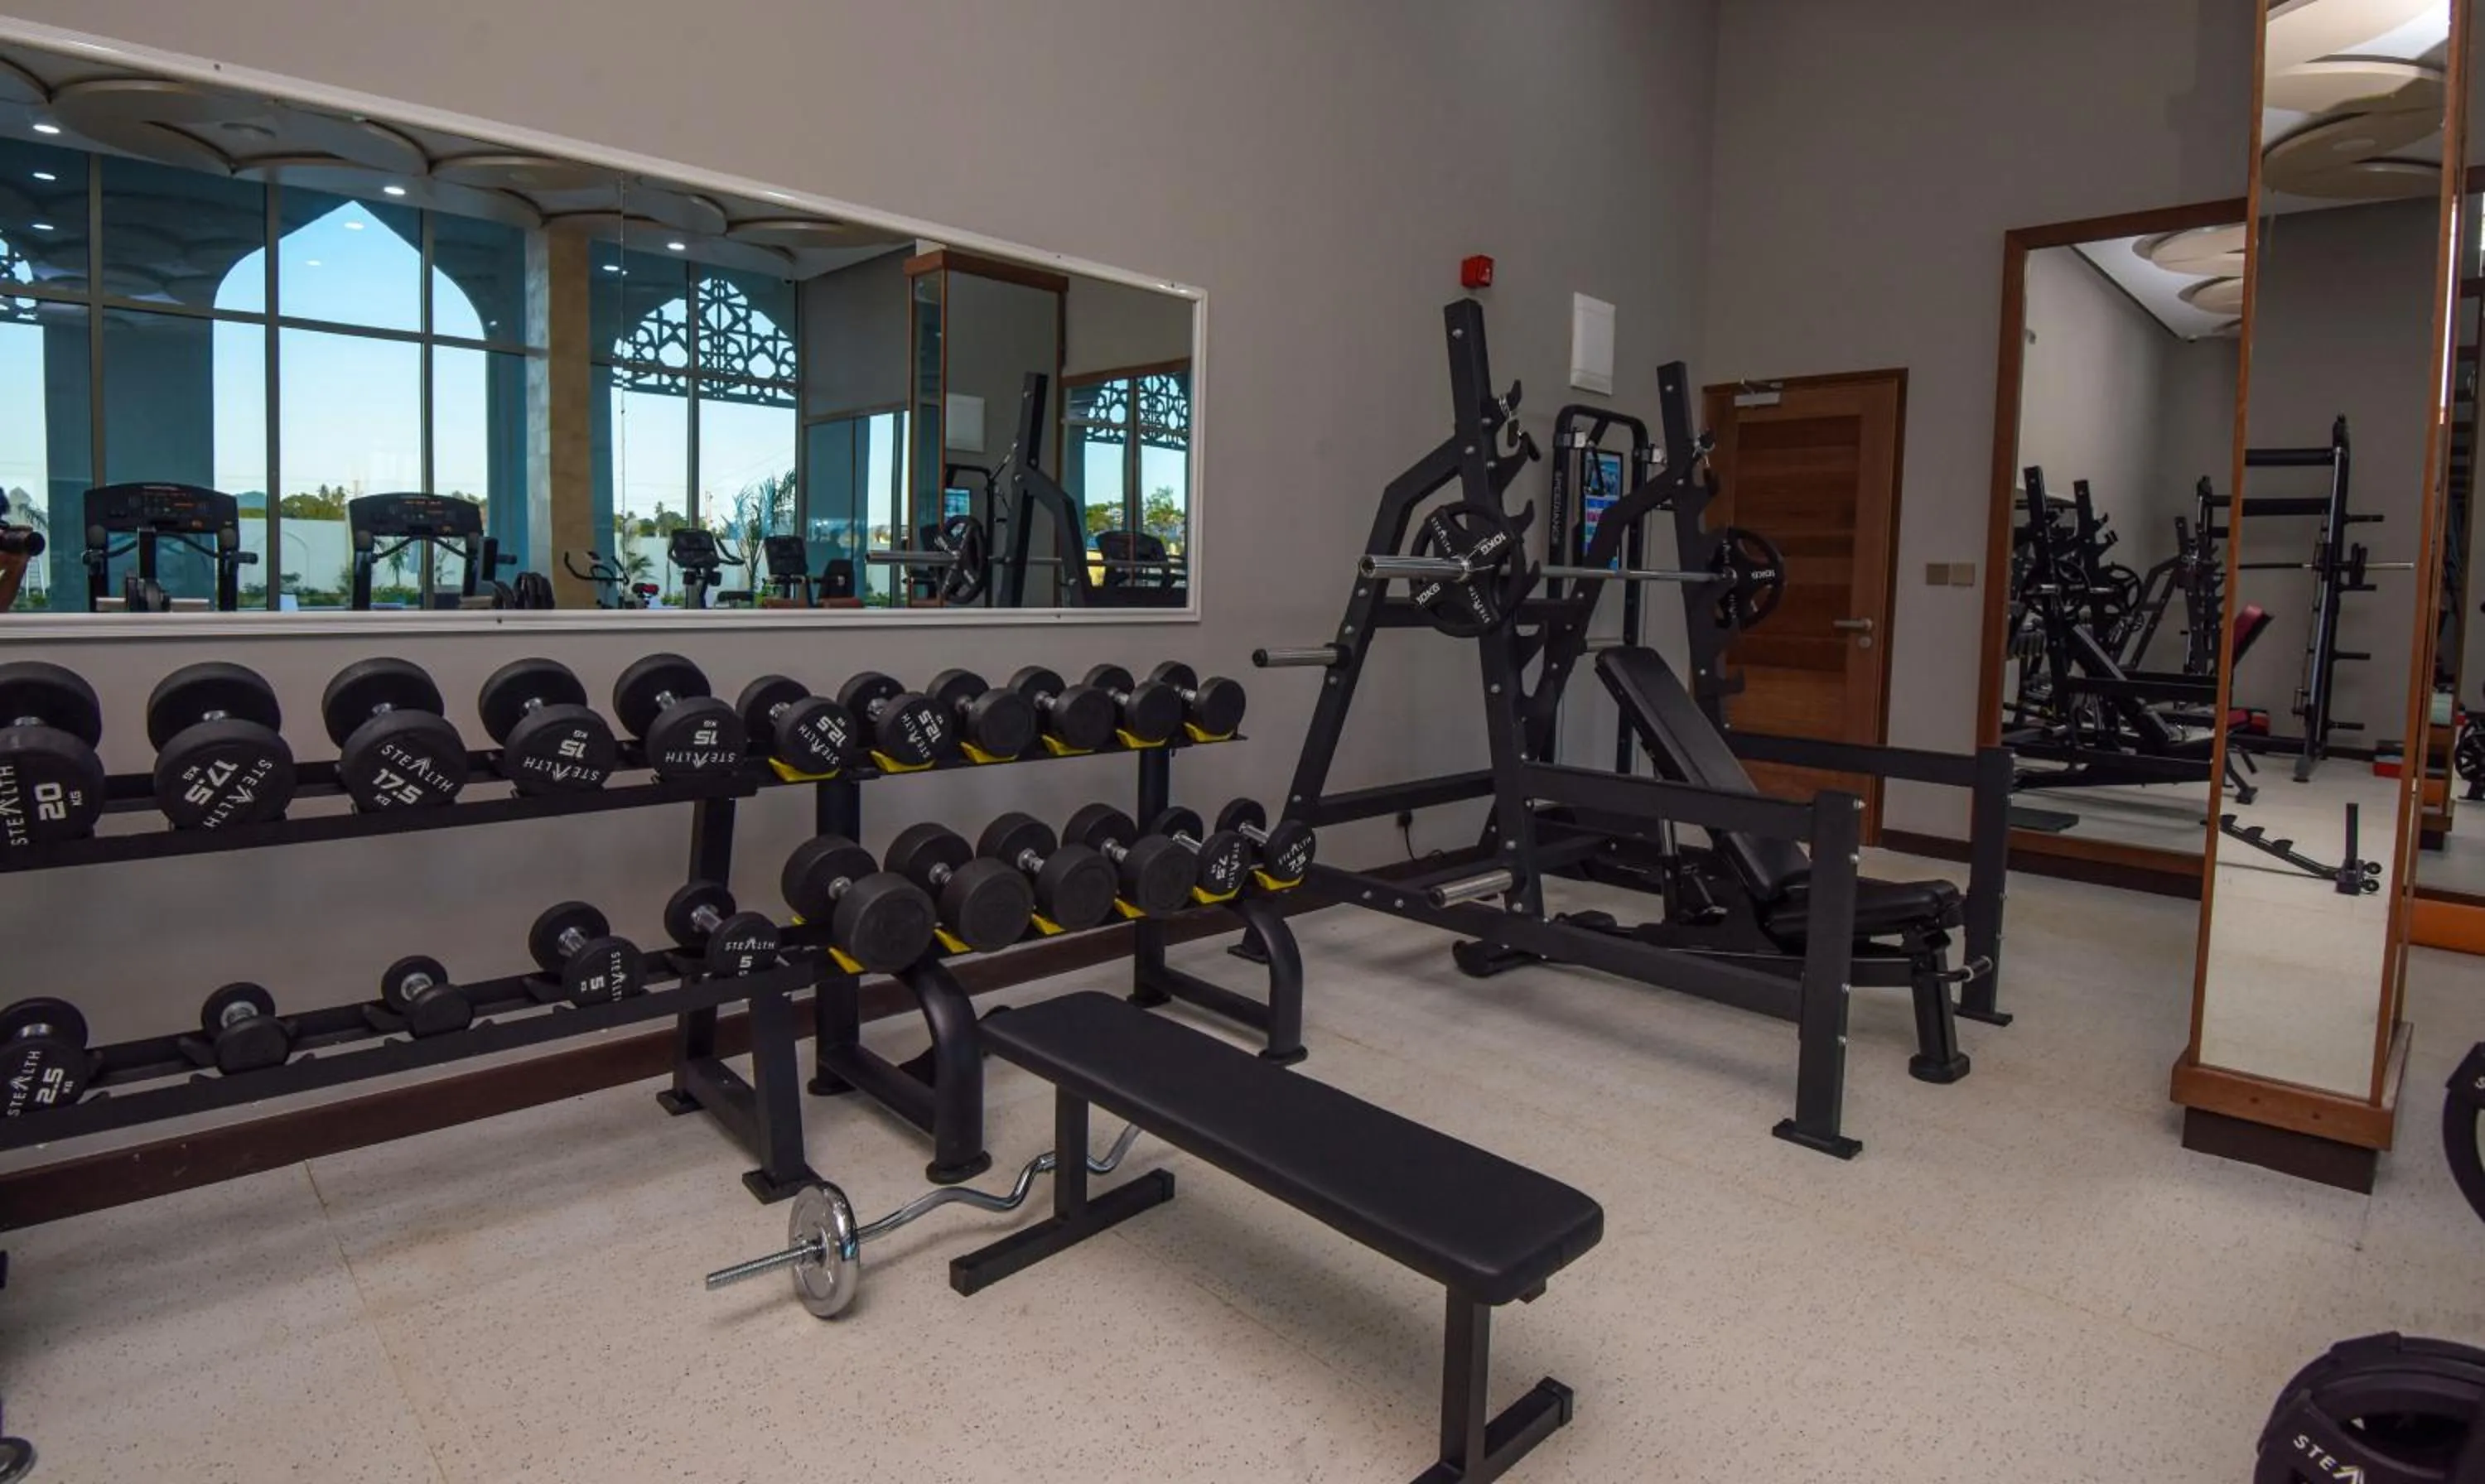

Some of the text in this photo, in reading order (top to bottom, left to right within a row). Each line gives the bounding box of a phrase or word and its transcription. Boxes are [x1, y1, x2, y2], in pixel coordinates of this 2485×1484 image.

[694, 730, 717, 744] 15
[816, 716, 847, 747] 12.5
[901, 713, 931, 758] STEALTH
[919, 710, 942, 742] 12.5
[558, 740, 586, 758] 15
[665, 752, 736, 768] STEALTH
[798, 724, 840, 765] STEALTH
[185, 759, 239, 806] 17.5
[381, 744, 454, 793] STEALTH
[523, 757, 601, 780] STEALTH
[35, 783, 66, 821] 20
[204, 759, 273, 827] STEALTH
[372, 768, 423, 804] 17.5
[726, 937, 775, 952] STEALTH
[739, 955, 753, 968] 5
[591, 976, 605, 990] 5
[7, 1051, 41, 1117] STEALTH
[36, 1067, 64, 1104] 2.5
